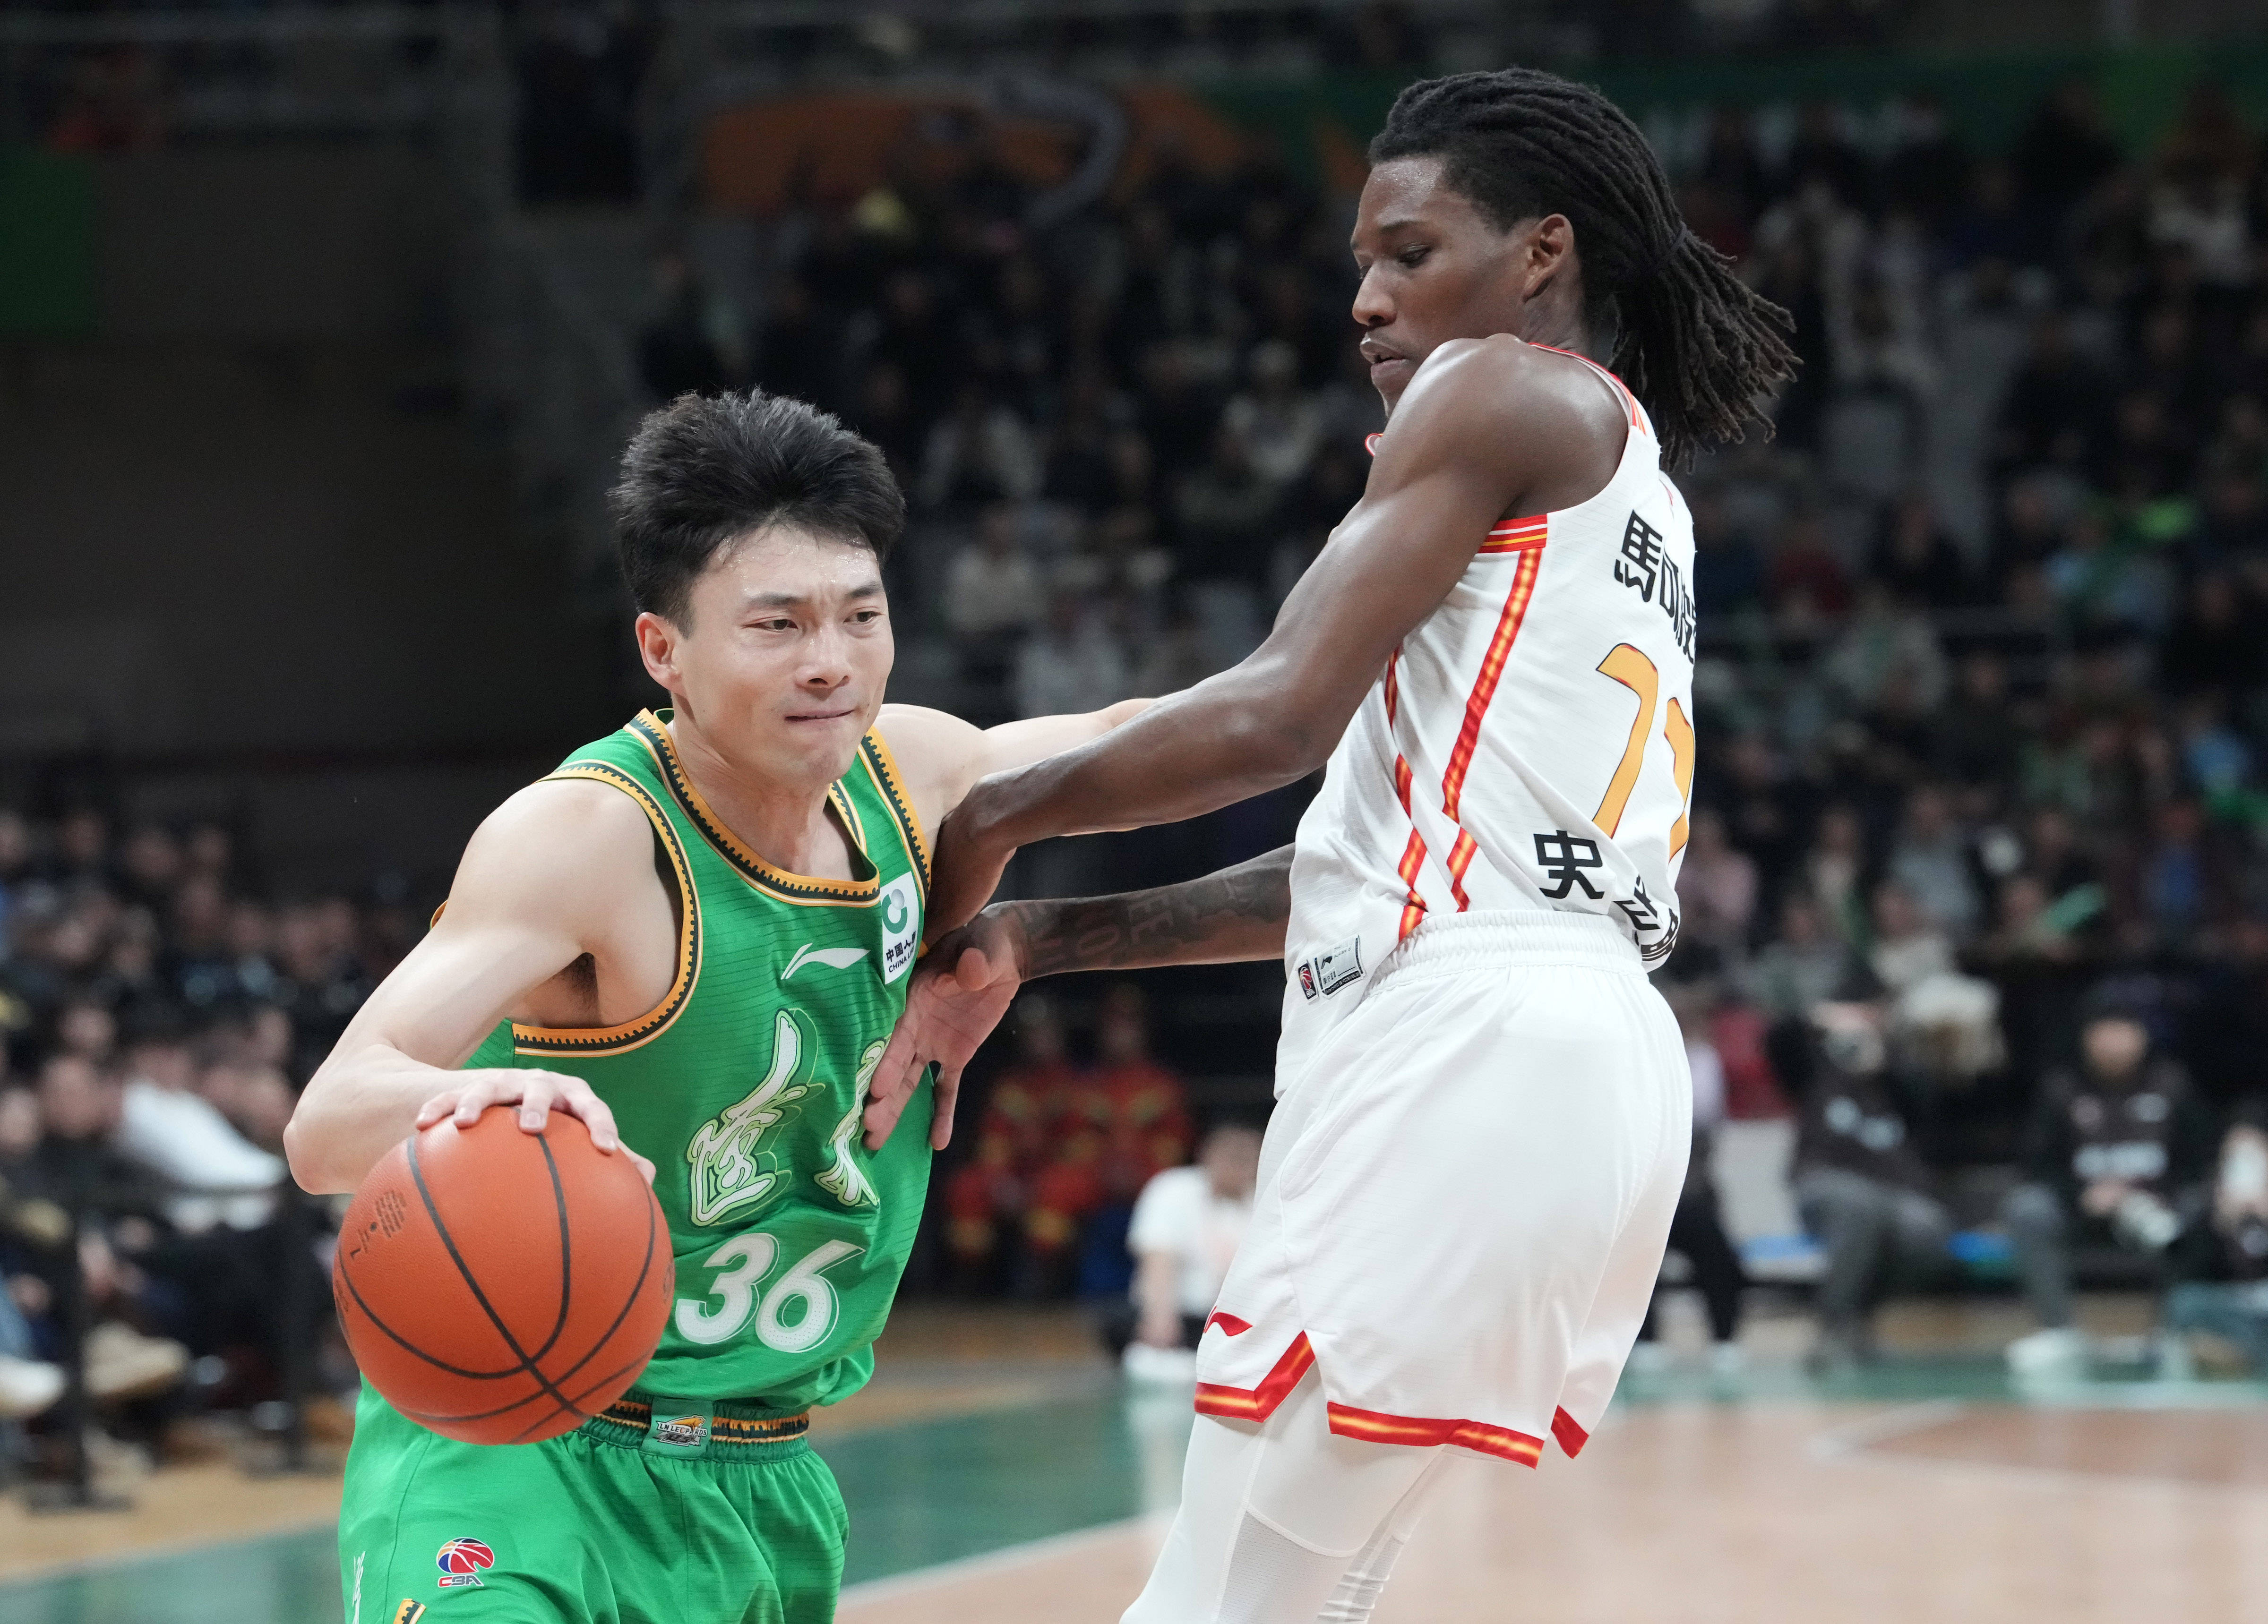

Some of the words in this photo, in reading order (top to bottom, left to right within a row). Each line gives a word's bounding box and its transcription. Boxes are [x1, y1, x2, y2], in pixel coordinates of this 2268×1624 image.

[1614, 509, 1697, 665] 馬可波
[889, 956, 907, 973] CHINA
[675, 1232, 866, 1353] 36
[671, 1425, 707, 1436] LEOPARDS
[438, 1574, 484, 1588] CBA
